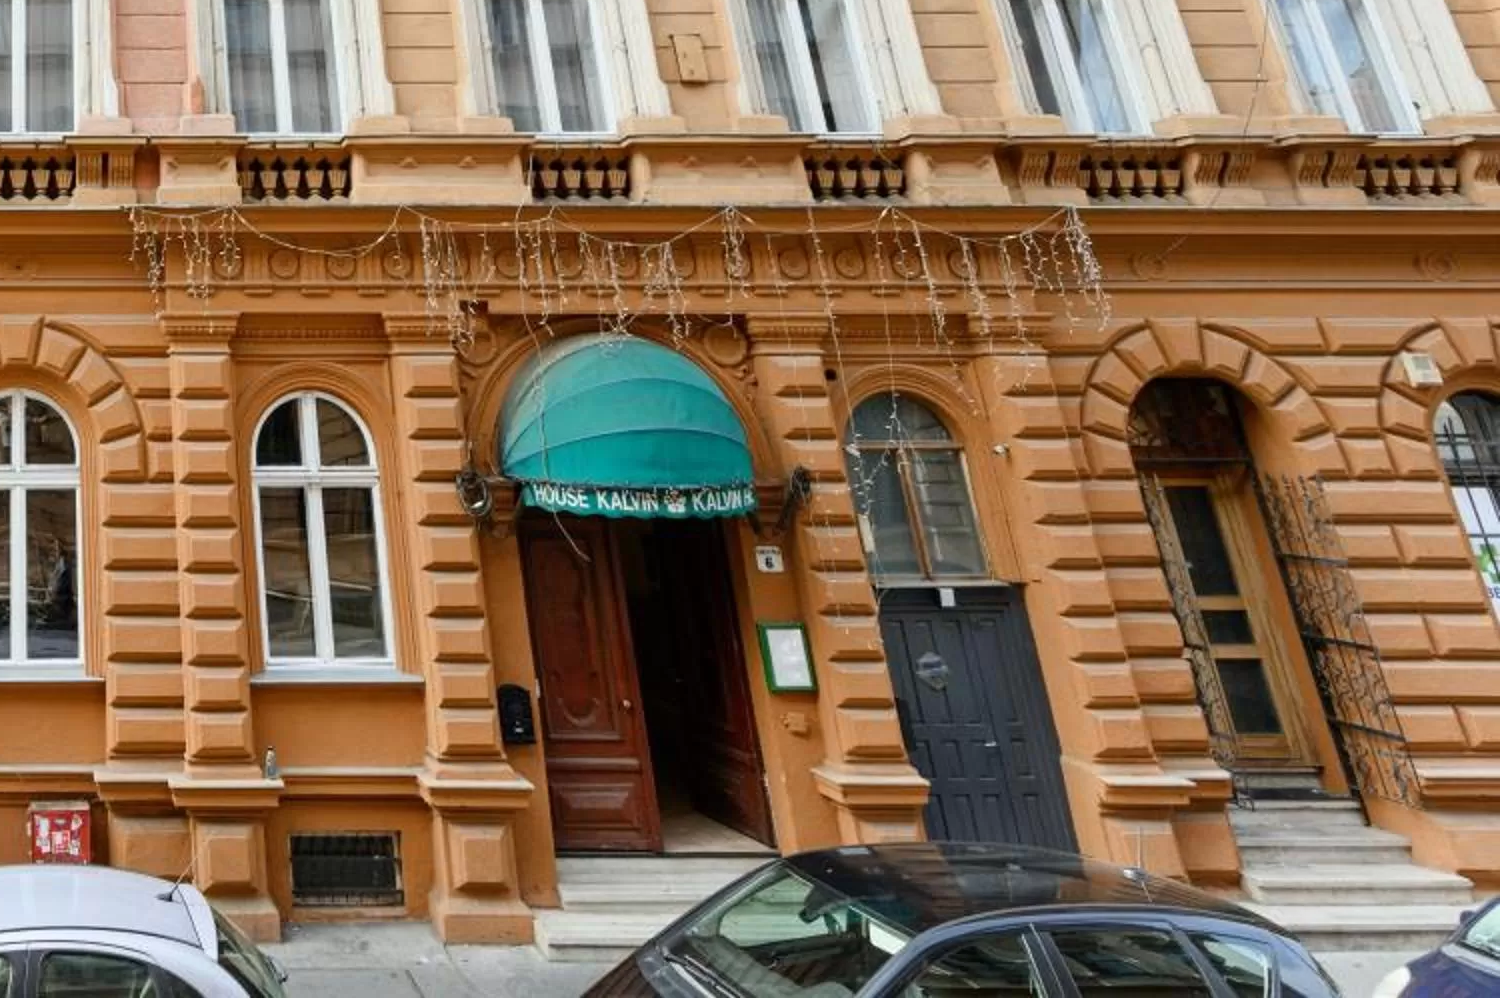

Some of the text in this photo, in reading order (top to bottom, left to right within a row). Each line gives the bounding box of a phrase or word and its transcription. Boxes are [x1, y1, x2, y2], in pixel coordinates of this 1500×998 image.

[533, 482, 590, 509] HOUSE
[596, 488, 660, 512] KALVIN
[765, 555, 775, 569] 6
